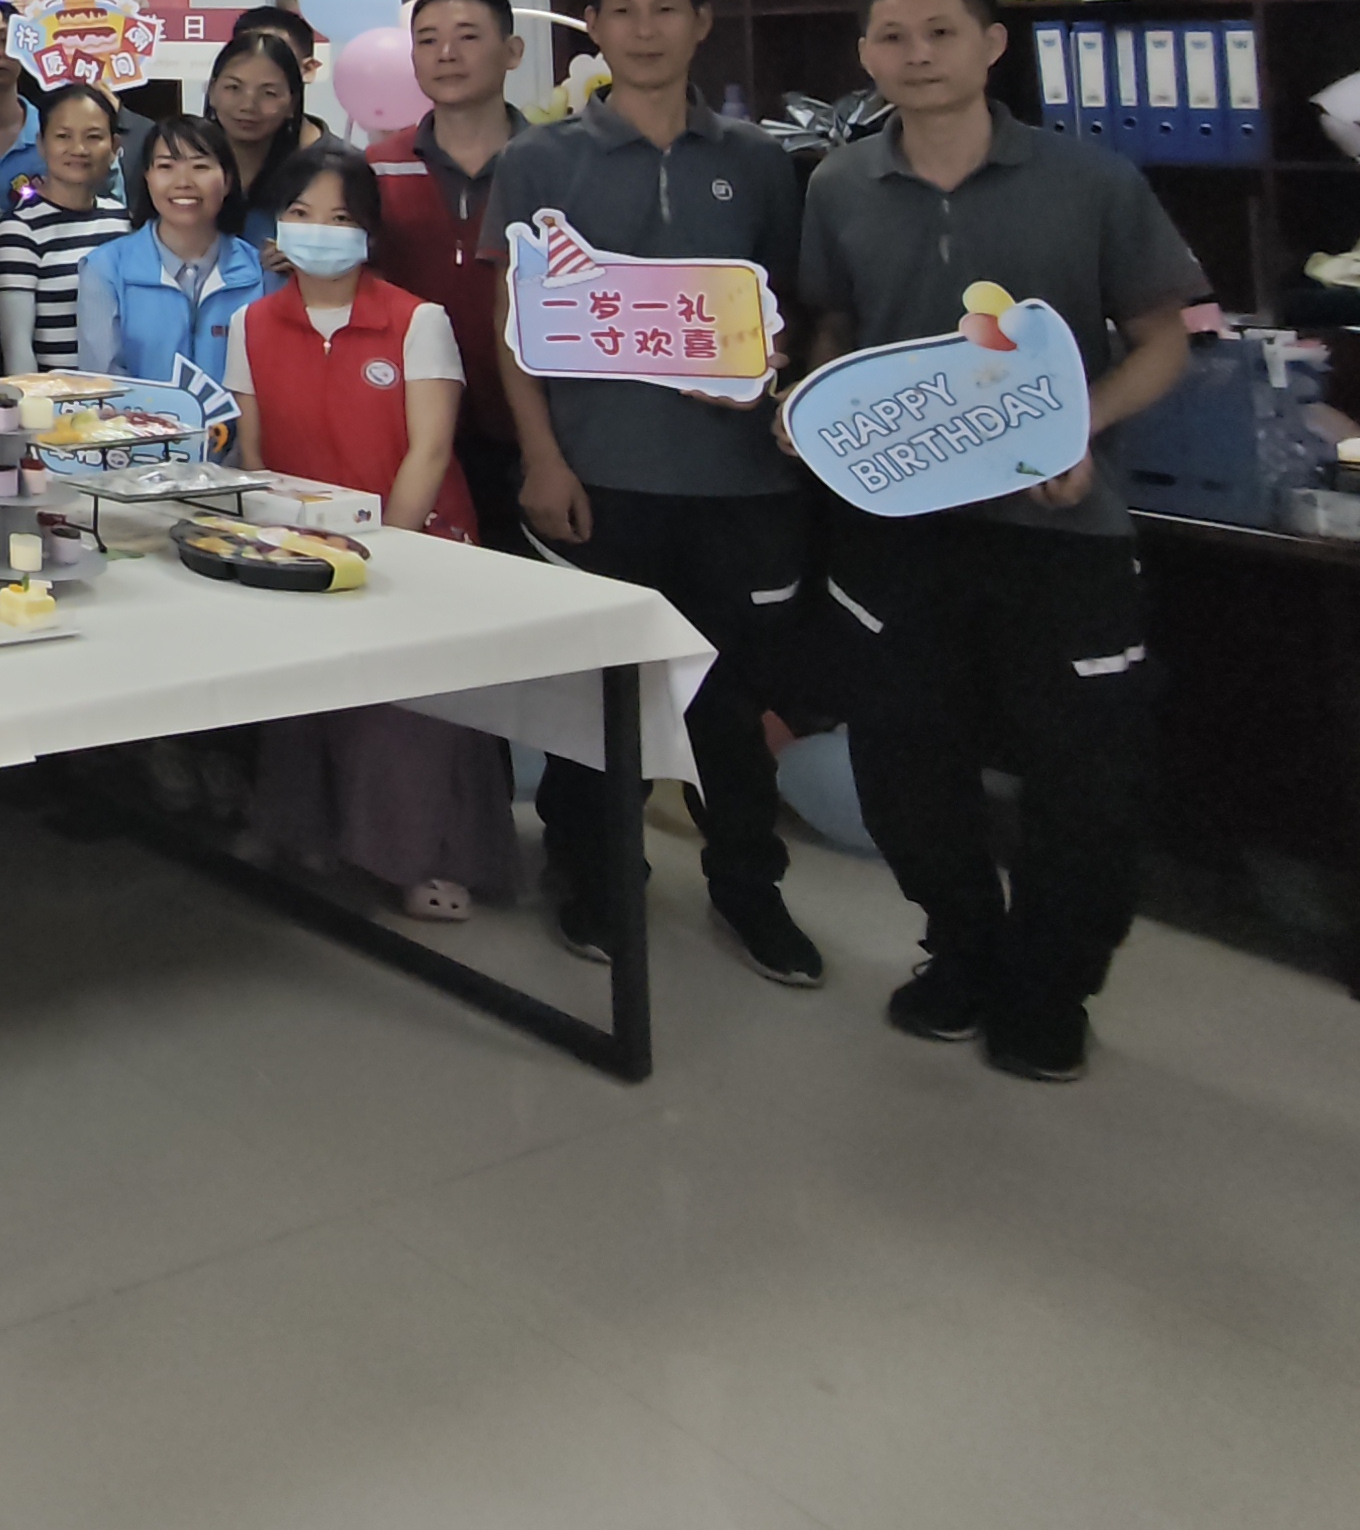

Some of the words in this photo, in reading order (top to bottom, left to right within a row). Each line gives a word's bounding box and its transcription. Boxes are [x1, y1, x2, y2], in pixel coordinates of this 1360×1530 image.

[542, 290, 717, 324] 一岁一礼
[545, 325, 719, 360] 一寸欢喜
[818, 372, 957, 457] HAPPY
[848, 375, 1063, 495] BIRTHDAY
